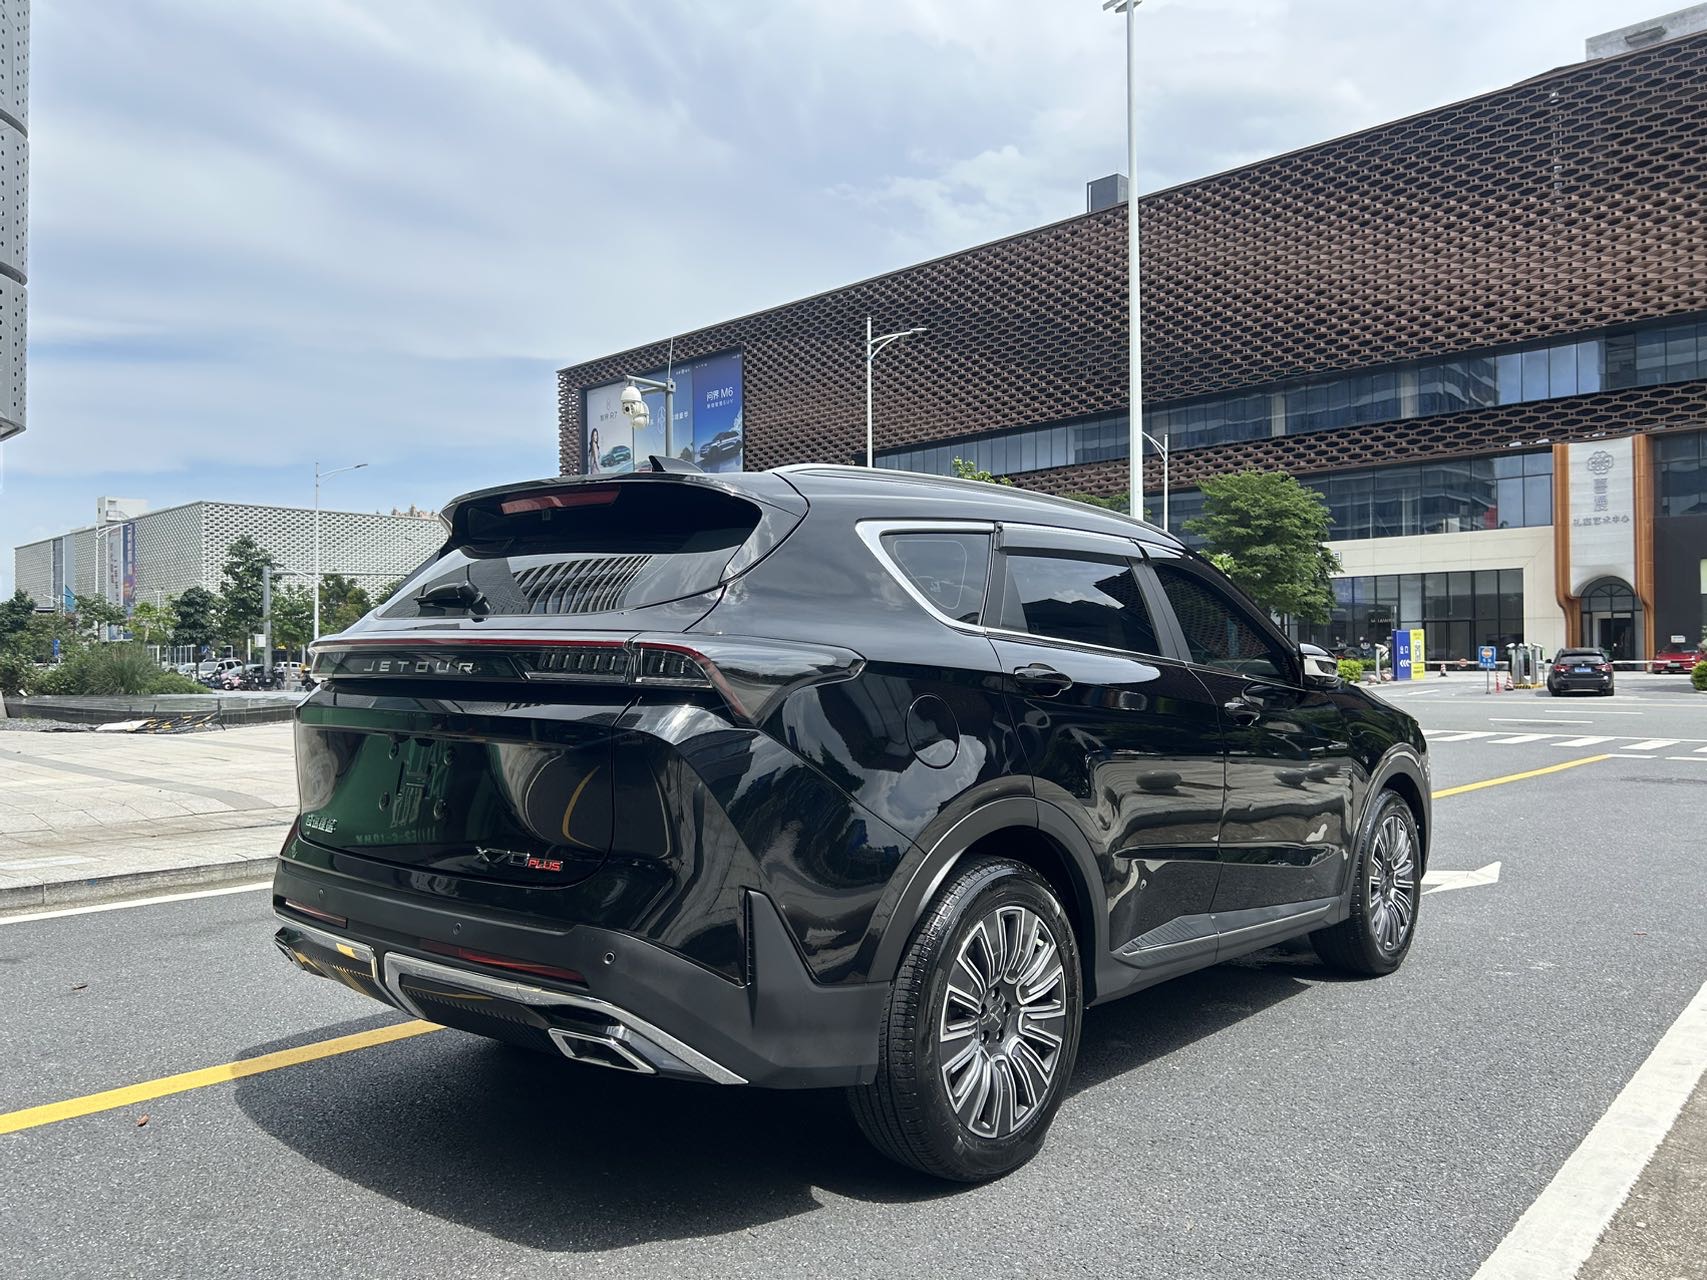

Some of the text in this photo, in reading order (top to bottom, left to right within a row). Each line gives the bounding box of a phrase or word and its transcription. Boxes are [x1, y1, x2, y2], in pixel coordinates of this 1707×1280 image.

[720, 386, 734, 398] M6
[363, 660, 474, 674] JETOUR
[473, 845, 563, 871] X70 PLUS
